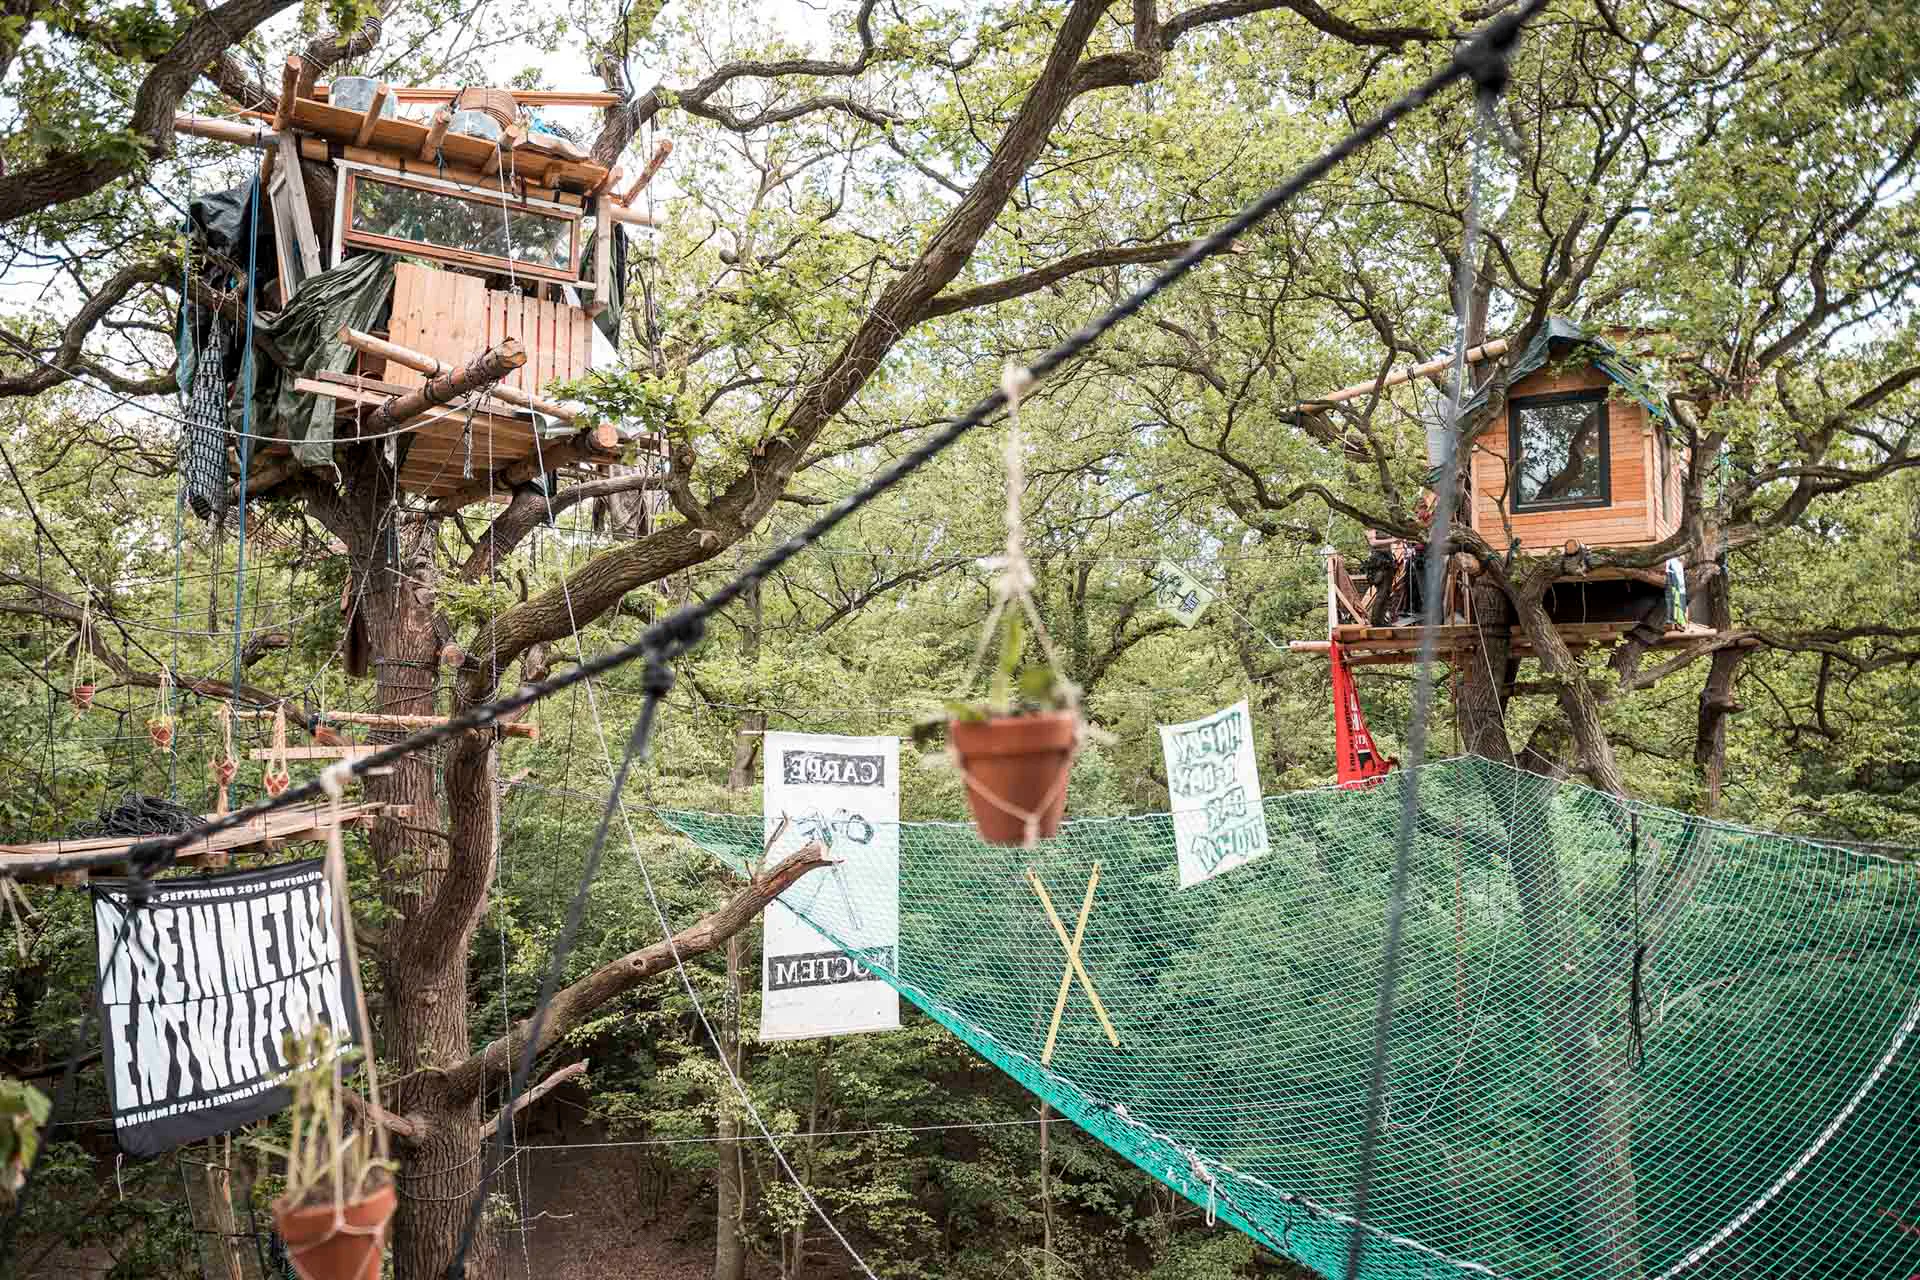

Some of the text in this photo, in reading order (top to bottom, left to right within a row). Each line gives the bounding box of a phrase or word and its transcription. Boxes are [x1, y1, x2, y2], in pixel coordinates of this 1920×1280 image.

[95, 878, 341, 1004] RHEINMETALL
[160, 887, 235, 902] SEPTEMBER
[109, 962, 351, 1110] ENTWAFFNEN
